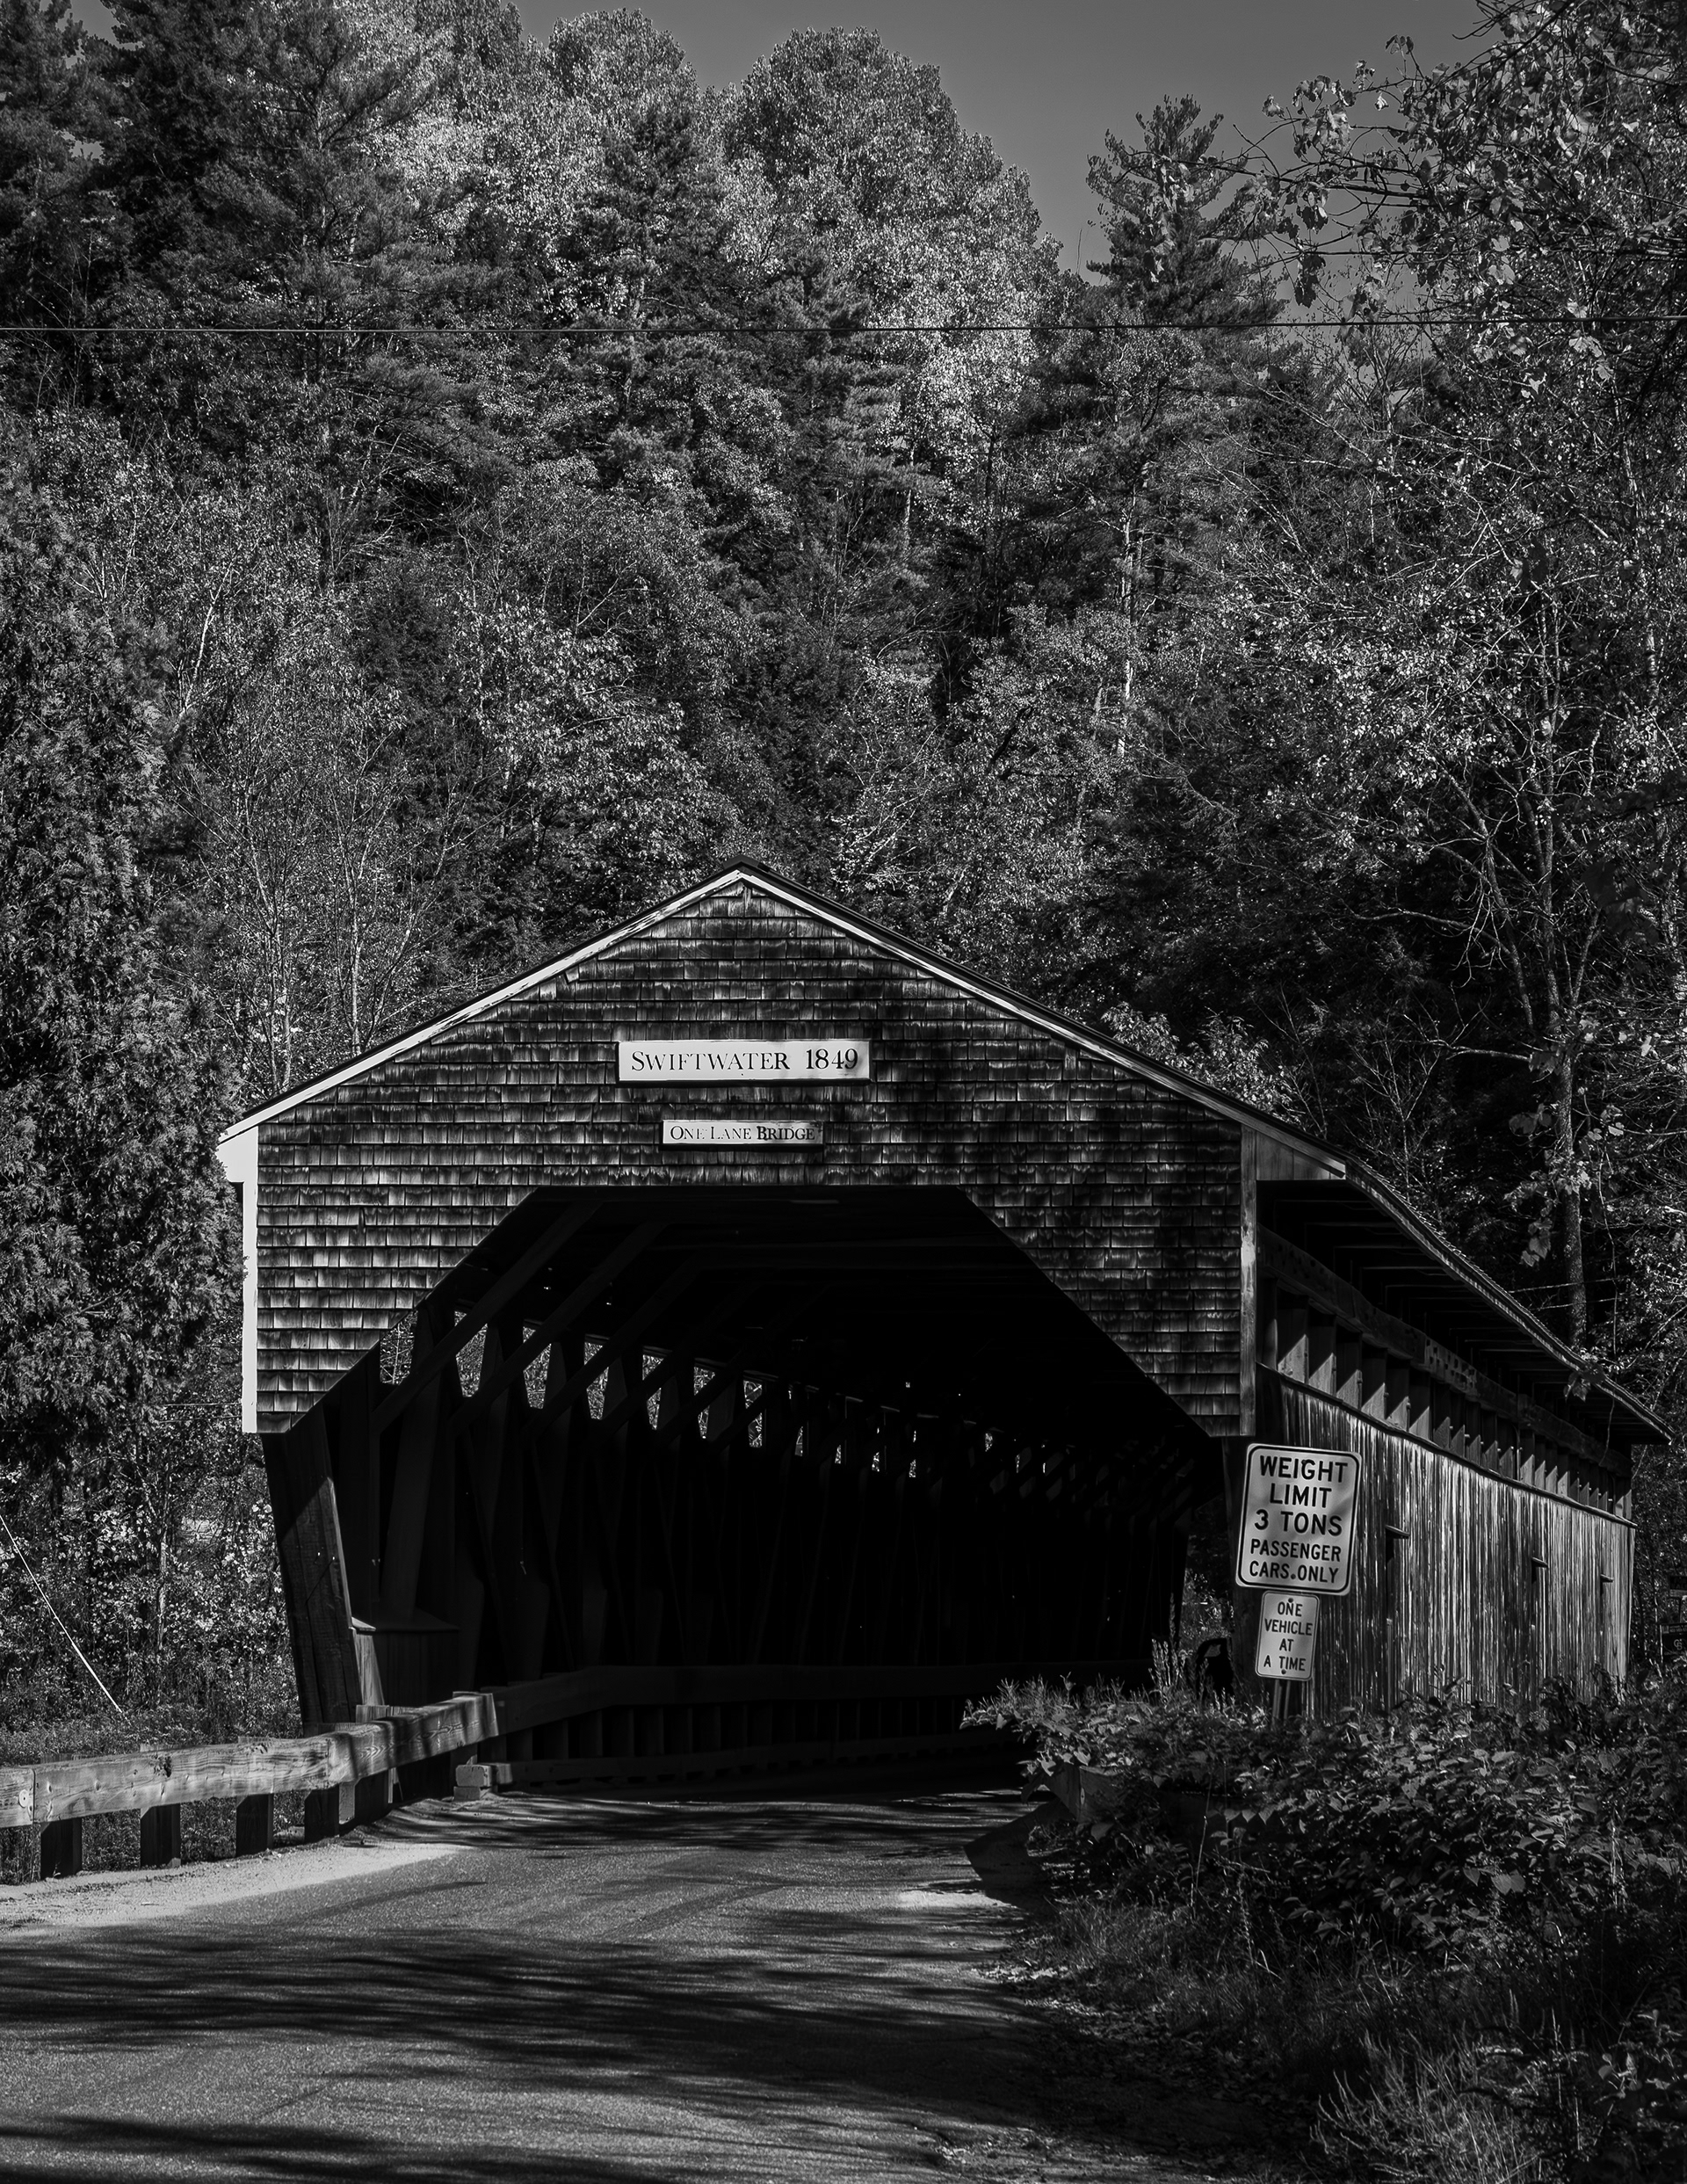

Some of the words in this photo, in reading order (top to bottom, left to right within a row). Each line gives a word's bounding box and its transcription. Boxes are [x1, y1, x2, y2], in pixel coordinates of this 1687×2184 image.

[631, 1050, 791, 1071] SWIFTWATER
[805, 1048, 859, 1070] 1849
[670, 1125, 707, 1140] ONE
[710, 1125, 752, 1140] LANE
[757, 1125, 815, 1141] BRIDGE
[1259, 1455, 1349, 1483] WEIGHT
[1270, 1483, 1332, 1508] LIMIT
[1254, 1508, 1269, 1530] 3
[1280, 1510, 1343, 1536] TONS
[1250, 1538, 1342, 1562] PASSENGER
[1249, 1560, 1290, 1579] CARS
[1297, 1564, 1339, 1584] ONLY
[1278, 1601, 1303, 1617] ONE
[1264, 1618, 1314, 1636] VEHICLE
[1278, 1638, 1294, 1651] AT
[1263, 1654, 1271, 1667] A
[1278, 1656, 1307, 1672] TIME
